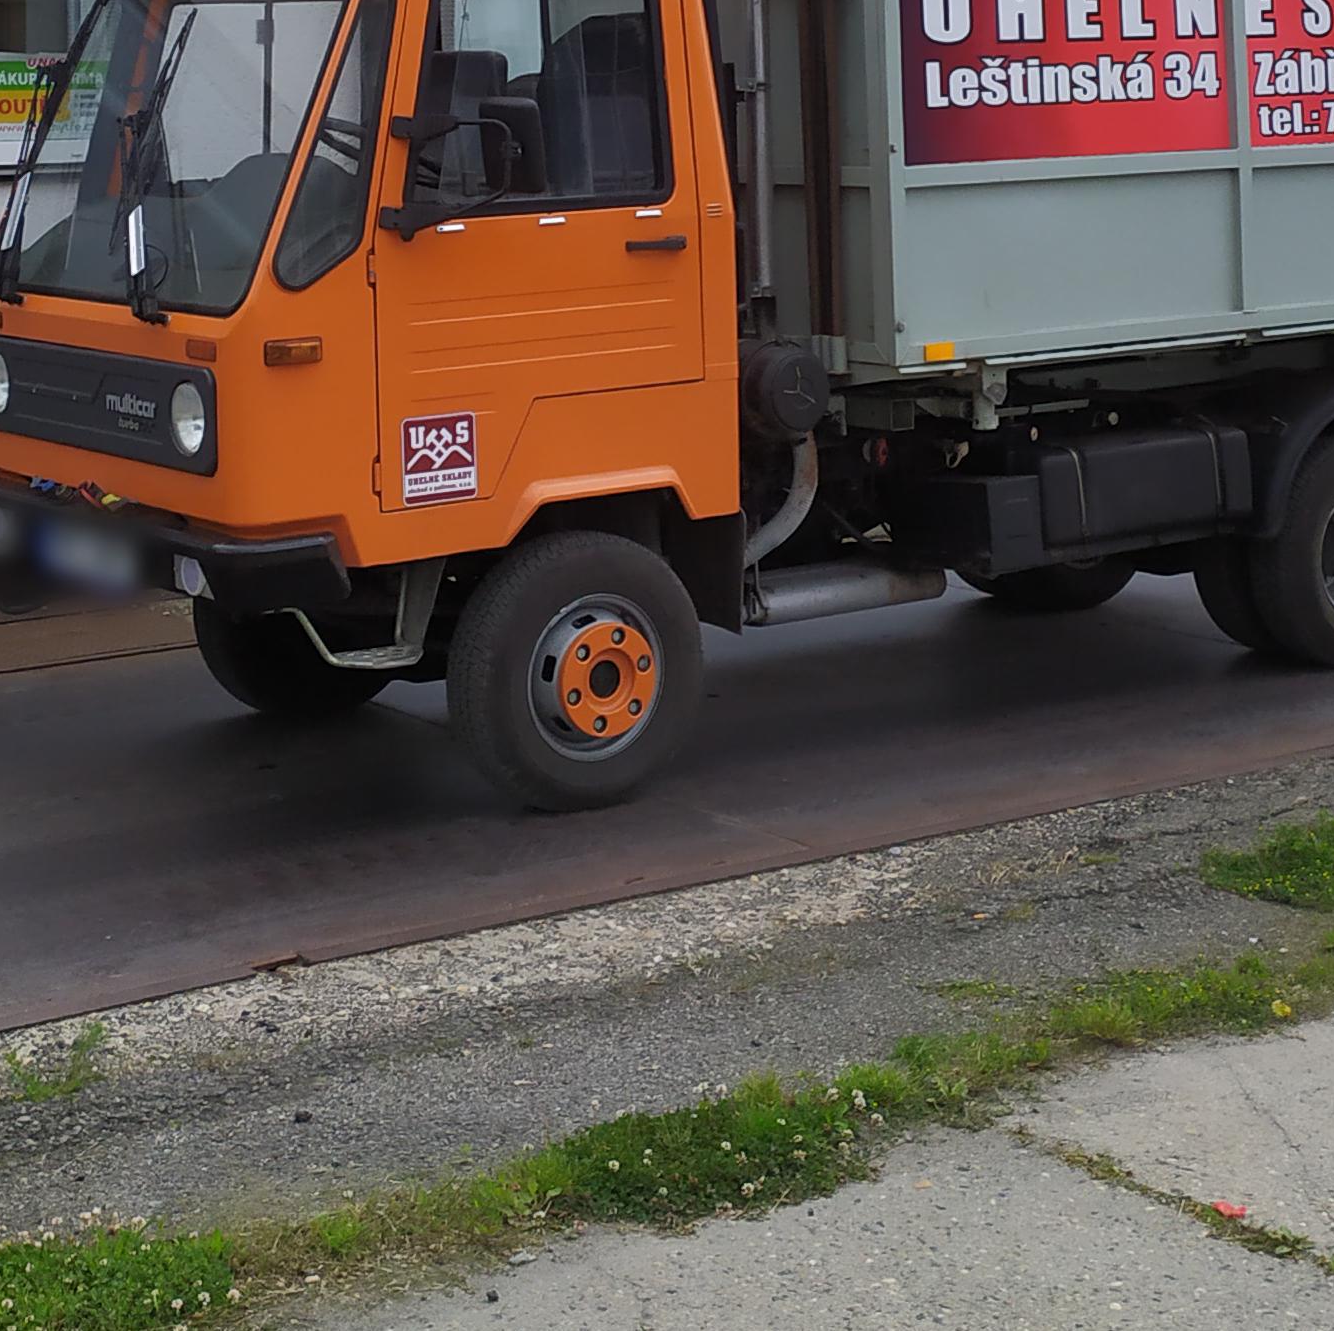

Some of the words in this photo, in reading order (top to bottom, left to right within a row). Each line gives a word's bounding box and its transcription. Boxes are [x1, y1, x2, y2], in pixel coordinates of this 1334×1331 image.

[924, 53, 1155, 109] Leštinská
[1163, 52, 1220, 99] 34
[106, 393, 156, 419] multicar
